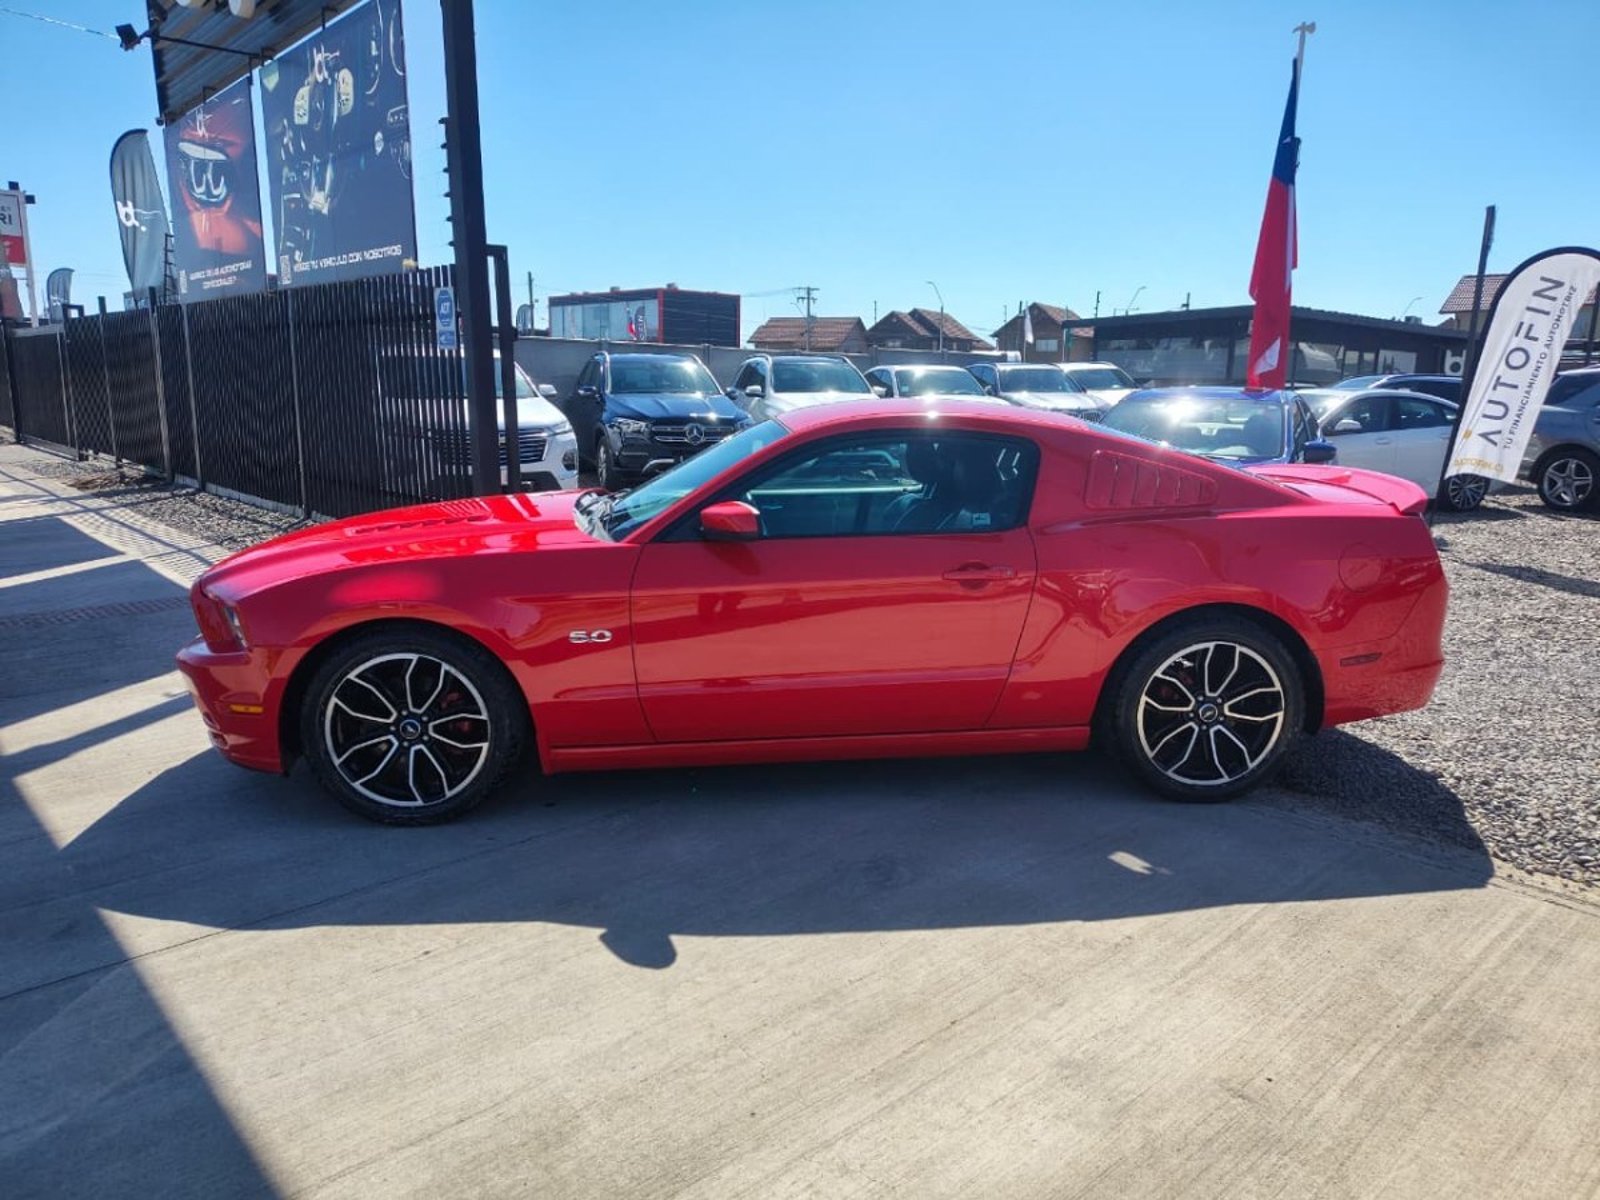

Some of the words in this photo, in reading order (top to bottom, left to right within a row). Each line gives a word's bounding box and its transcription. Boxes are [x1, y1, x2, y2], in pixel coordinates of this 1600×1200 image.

[1478, 275, 1565, 447] AUTOFIN
[1510, 352, 1548, 436] FINANCIAMIENTO
[1545, 284, 1577, 349] AUTOMOTRIZ
[568, 629, 612, 644] 5.0
